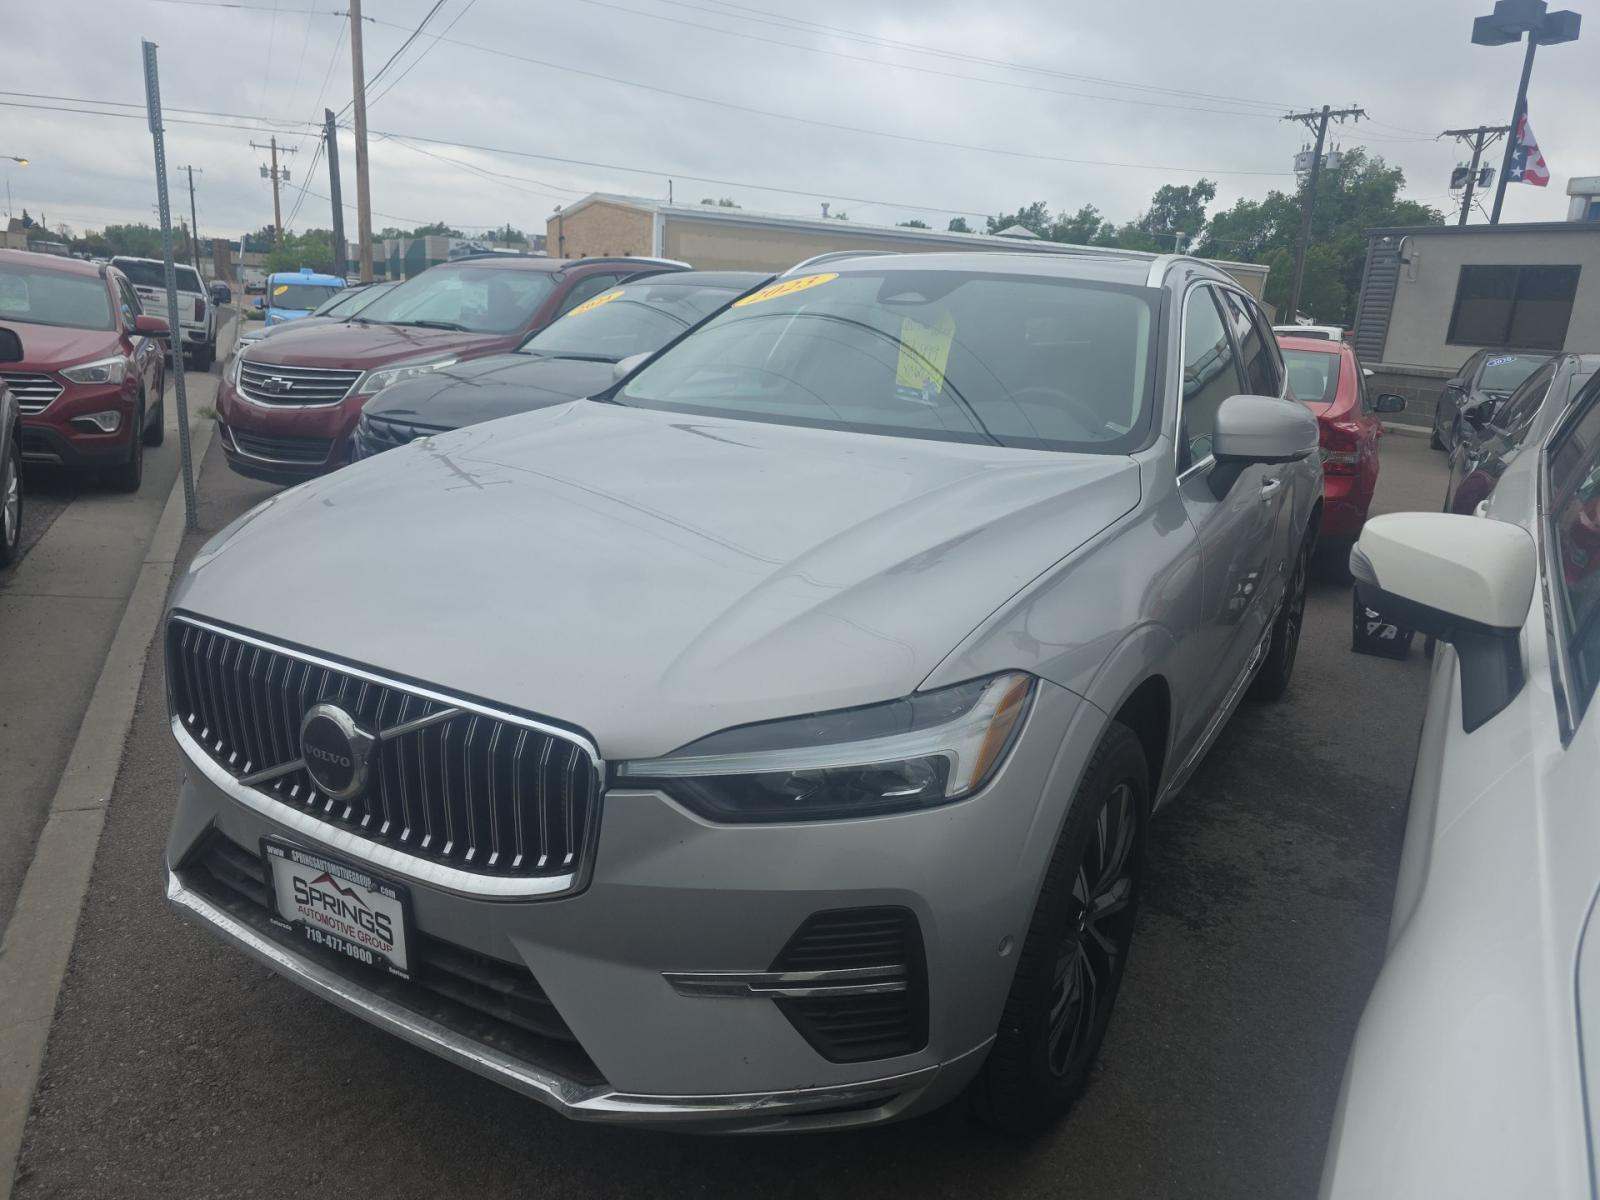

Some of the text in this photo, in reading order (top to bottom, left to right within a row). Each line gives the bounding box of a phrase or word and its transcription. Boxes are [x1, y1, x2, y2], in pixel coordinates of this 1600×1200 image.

[305, 743, 351, 767] VOLVO
[293, 876, 393, 946] SPRINGS
[297, 905, 355, 938] AUTOMOTIVE
[357, 929, 393, 952] GROUP
[305, 927, 372, 964] 719-477-0900
